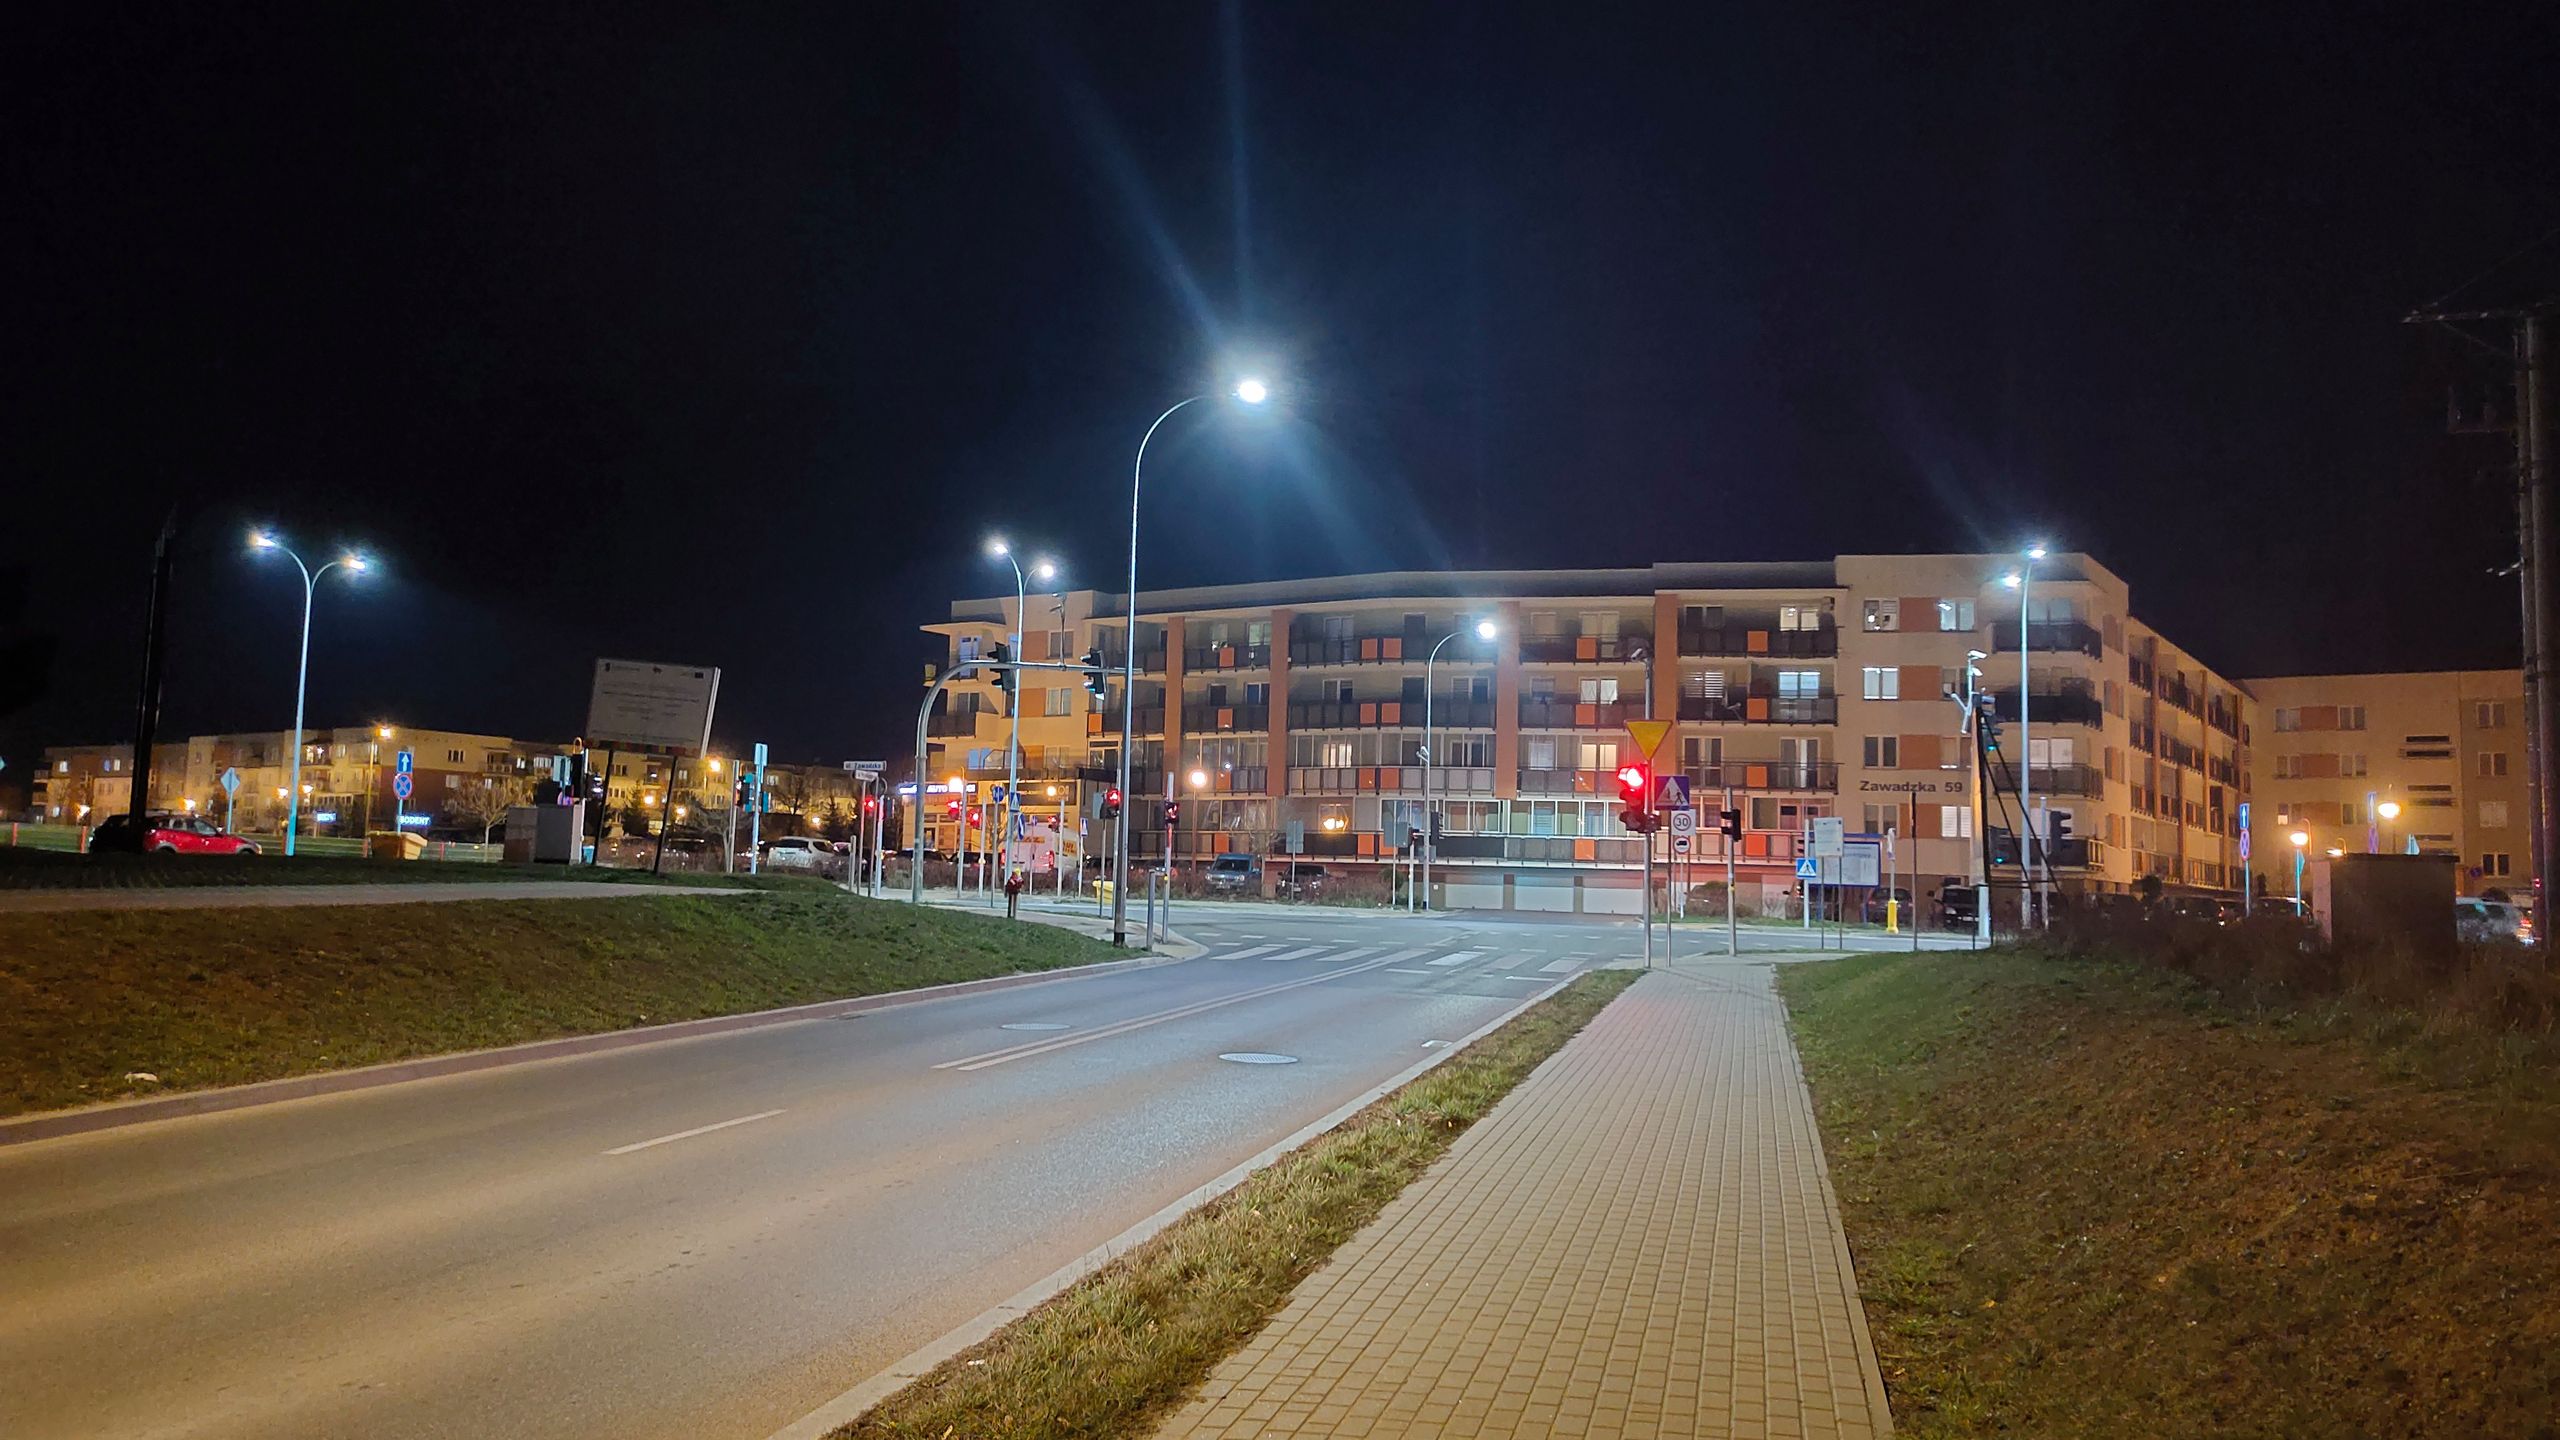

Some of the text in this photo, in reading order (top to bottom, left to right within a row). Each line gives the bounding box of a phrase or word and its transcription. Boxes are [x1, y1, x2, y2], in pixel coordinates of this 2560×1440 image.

[926, 784, 948, 793] AUTO
[1860, 780, 1963, 792] Zawadzka 59
[1676, 818, 1688, 827] 30
